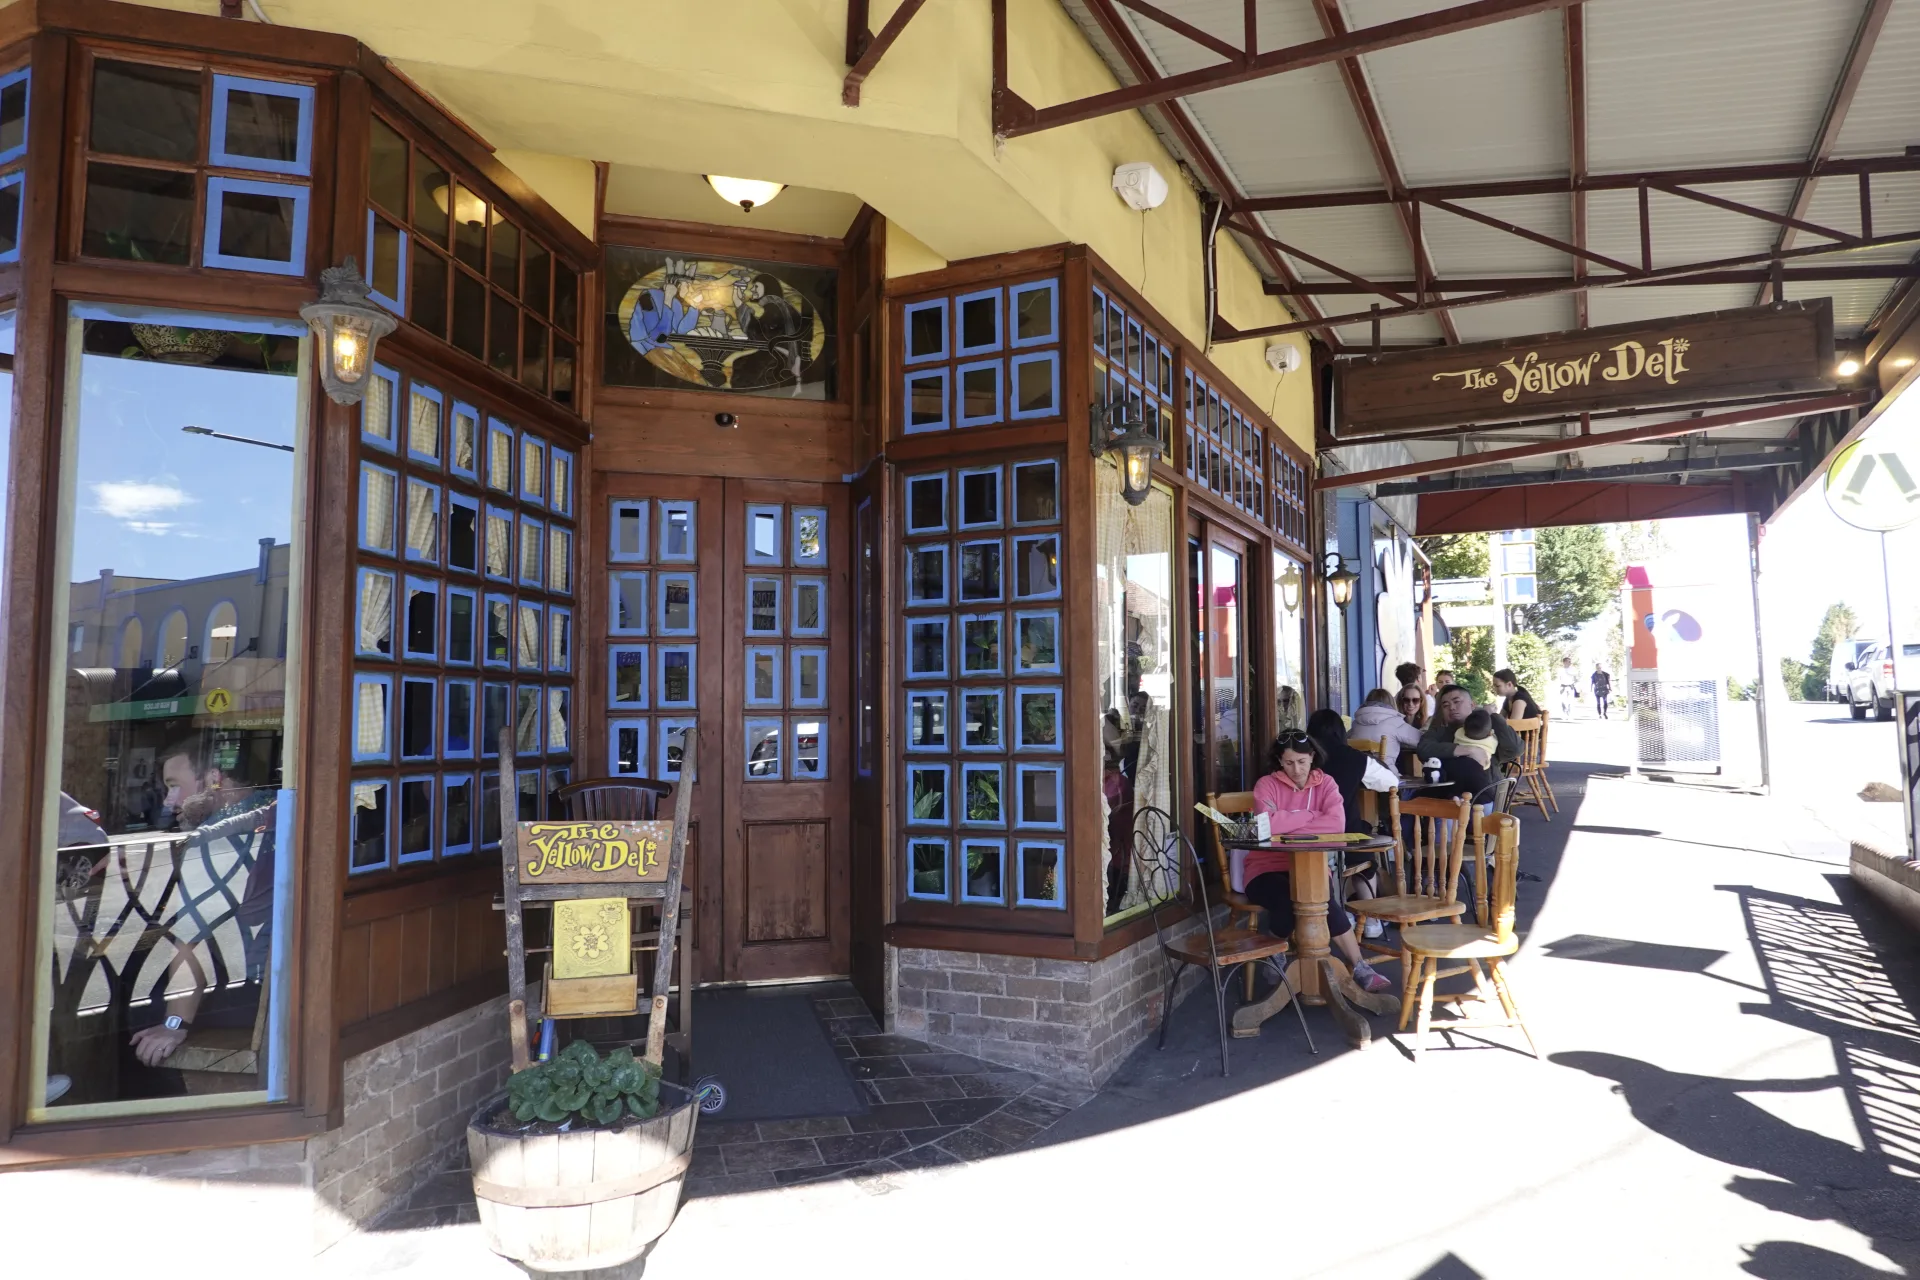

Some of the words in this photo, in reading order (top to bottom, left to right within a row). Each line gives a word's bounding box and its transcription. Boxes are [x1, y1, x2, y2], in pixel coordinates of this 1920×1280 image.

[1432, 368, 1498, 390] The
[1497, 351, 1601, 403] Yellow
[1602, 338, 1690, 385] Deli
[531, 823, 619, 841] The
[527, 834, 601, 876] Yellow
[591, 838, 659, 876] Deli
